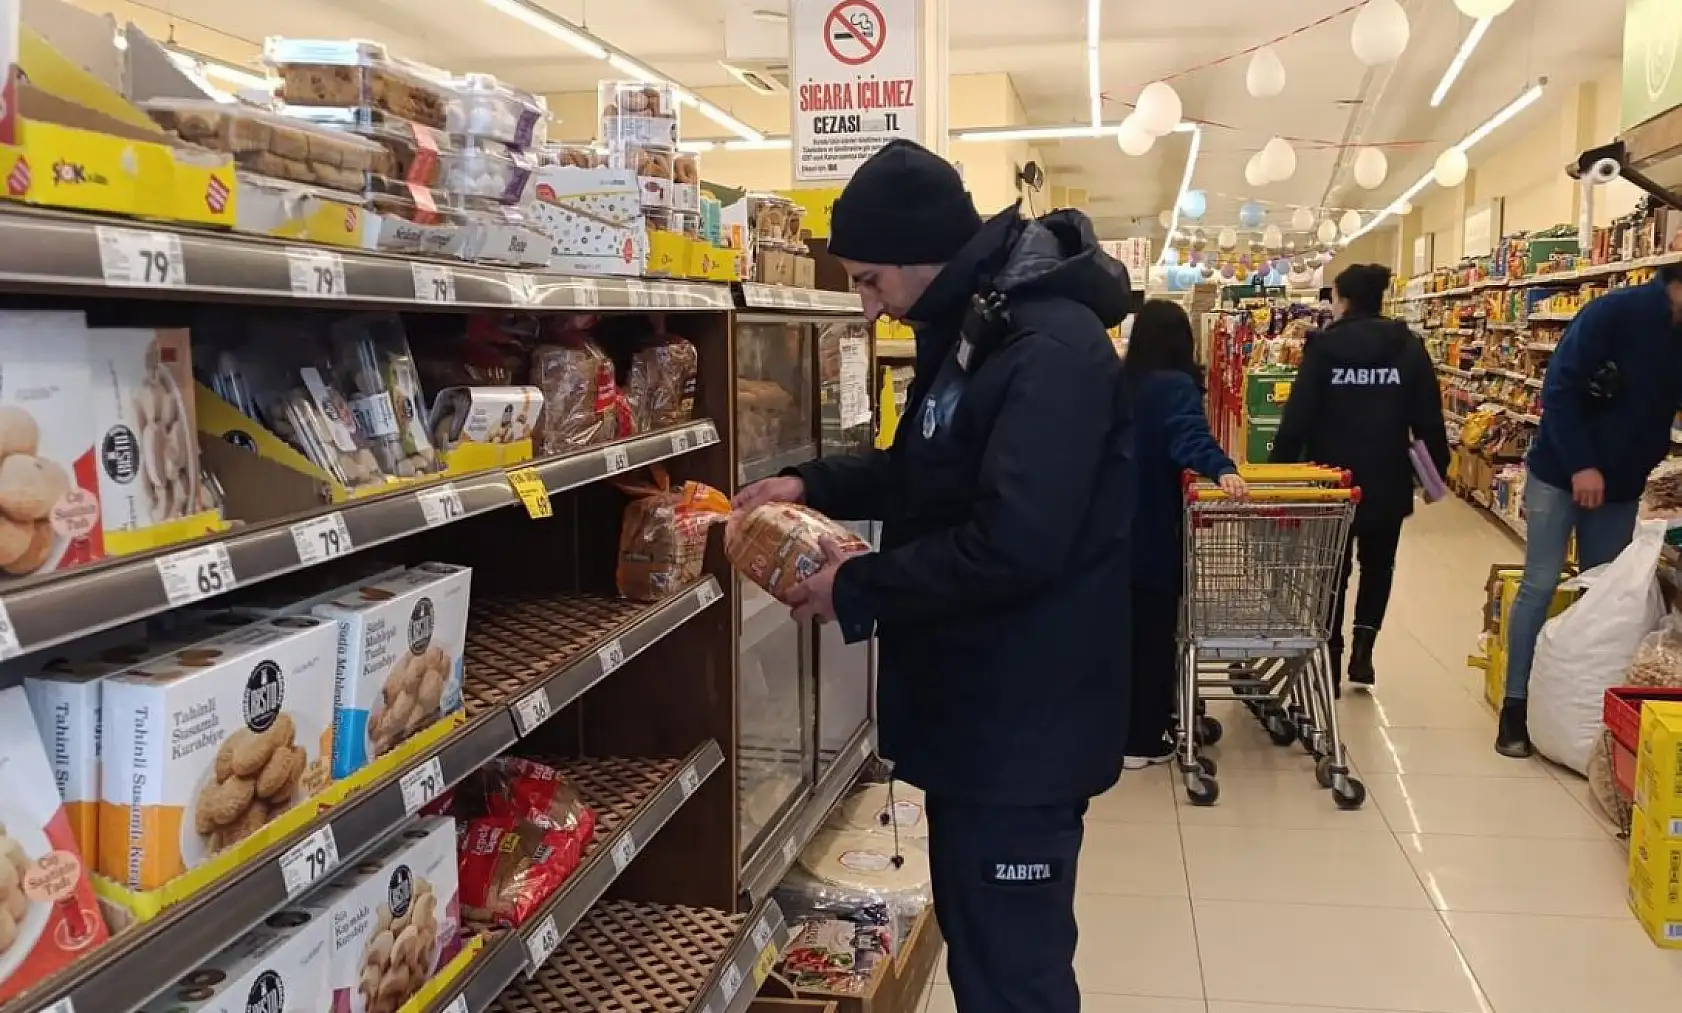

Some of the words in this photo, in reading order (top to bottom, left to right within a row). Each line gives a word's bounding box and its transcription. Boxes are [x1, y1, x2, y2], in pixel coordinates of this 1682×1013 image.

[800, 77, 853, 112] SİGARA
[857, 74, 914, 113] İÇİLMEZ
[814, 115, 861, 134] CEZASI
[884, 113, 901, 131] TL
[139, 250, 169, 284] 79
[312, 266, 333, 294] 79
[432, 278, 448, 301] 79
[1331, 367, 1401, 385] ZABITA
[318, 529, 339, 557] 79
[197, 561, 222, 593] 65
[173, 697, 216, 726] Tahinli
[55, 703, 69, 766] Tahinli
[134, 706, 149, 768] Tahinli
[172, 713, 220, 743] Susamlı
[172, 729, 223, 760] Kurabiye
[420, 774, 435, 802] 79
[305, 847, 326, 881] 79
[995, 863, 1051, 880] ZABITA
